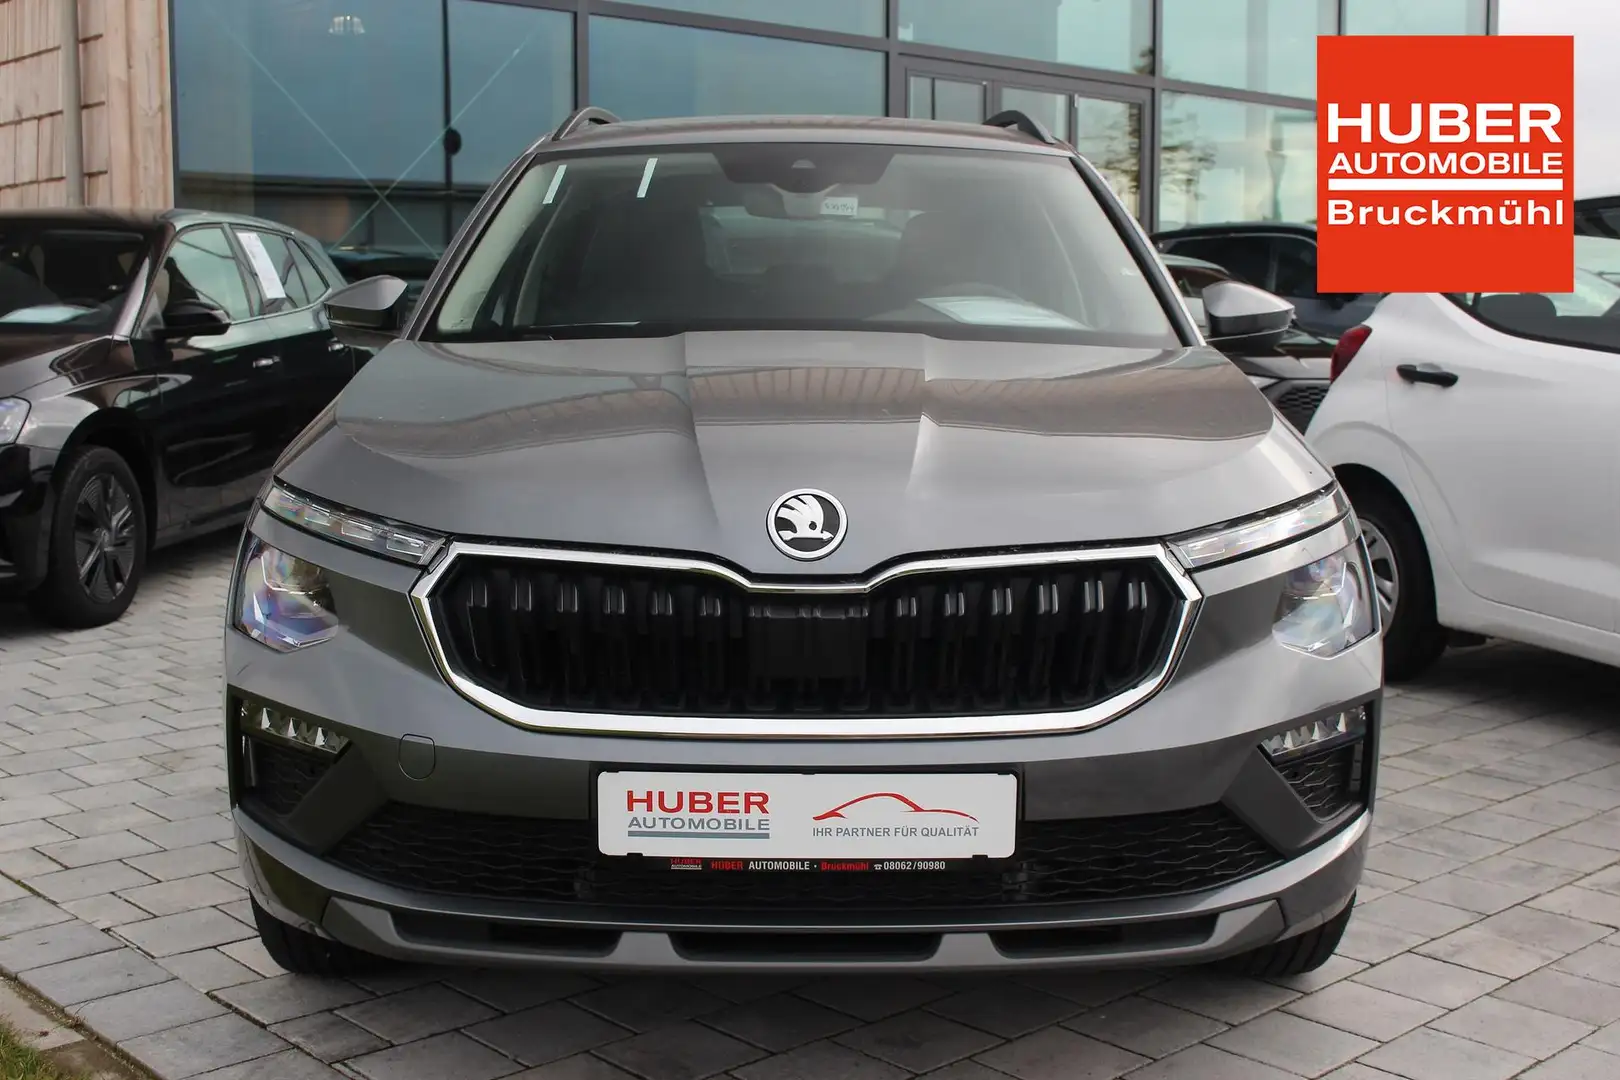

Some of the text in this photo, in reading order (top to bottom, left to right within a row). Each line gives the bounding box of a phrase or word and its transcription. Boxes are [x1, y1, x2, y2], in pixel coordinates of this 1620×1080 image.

[626, 790, 770, 814] HUBER
[627, 816, 771, 831] AUTOMOBILE
[812, 825, 979, 838] IHR PARTNER FÜR QUALITÄT
[711, 861, 946, 871] HUBER AUTOMOBILE Bruckmühl 08062/90980
